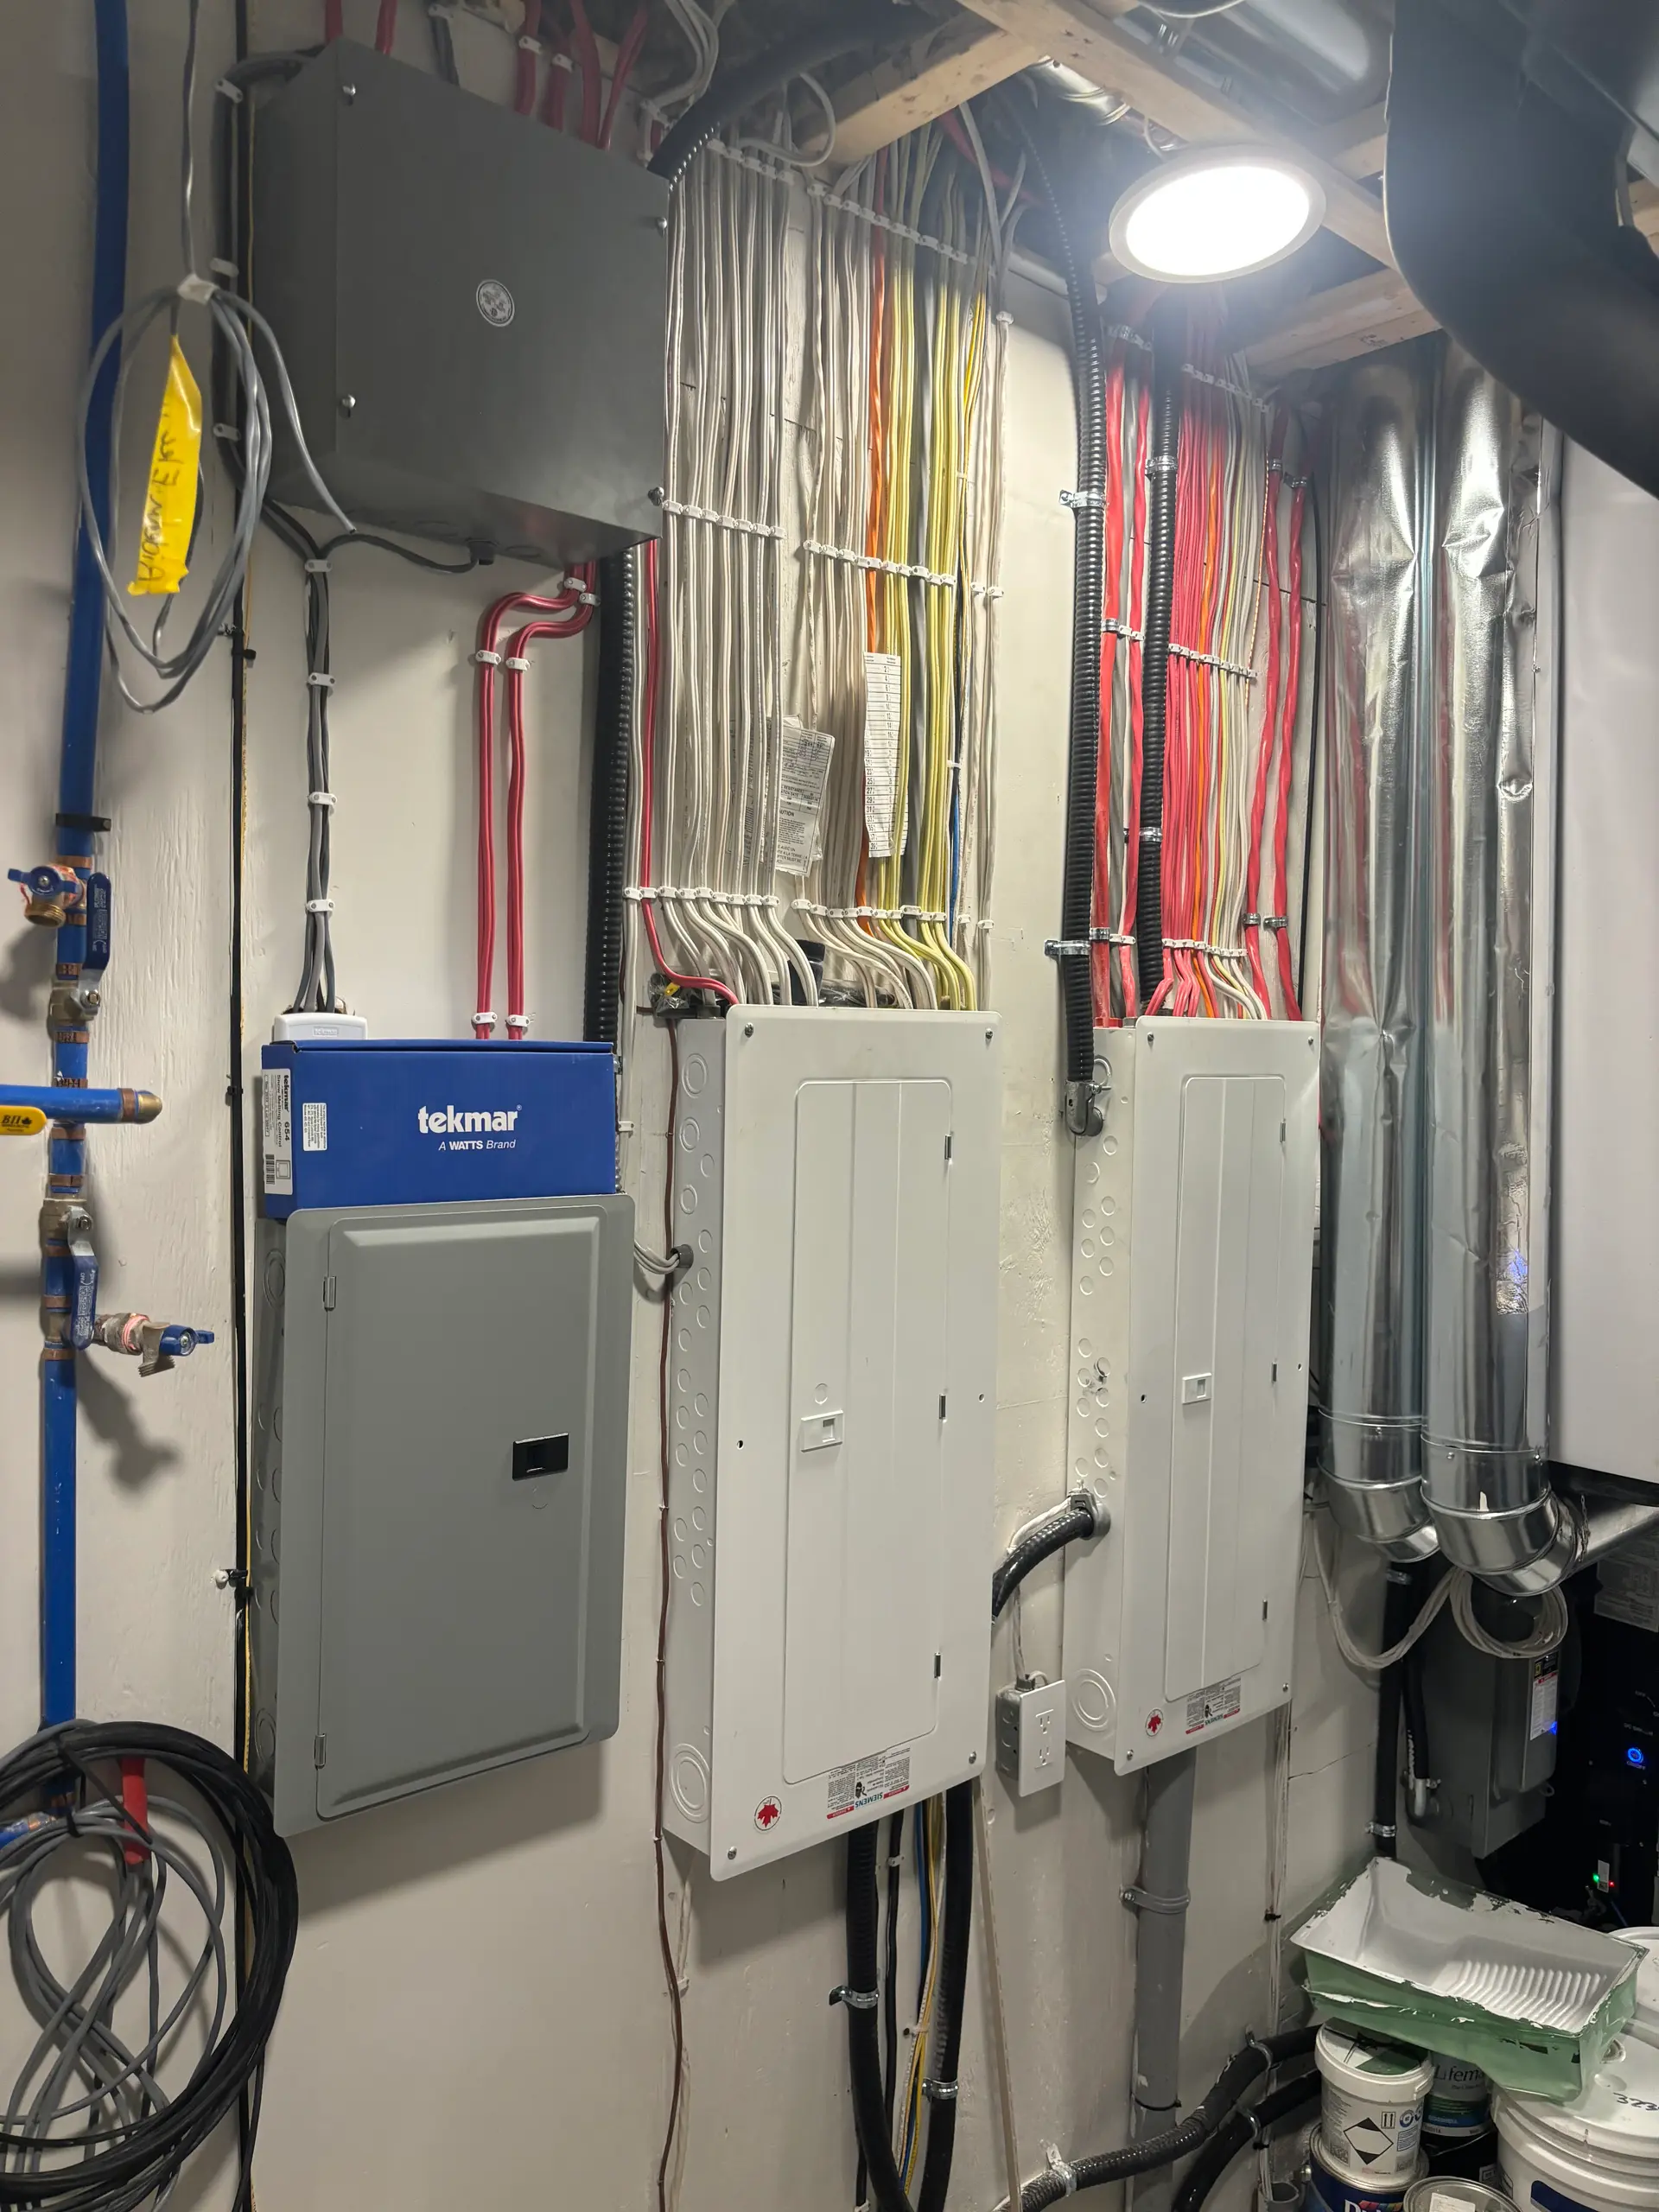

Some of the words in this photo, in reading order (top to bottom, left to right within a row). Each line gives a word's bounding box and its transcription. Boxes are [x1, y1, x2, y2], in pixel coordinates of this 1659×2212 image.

[418, 1105, 518, 1134] tekmar
[438, 1141, 446, 1150] A
[449, 1141, 483, 1150] WATTS
[486, 1140, 516, 1149] Brand
[855, 1792, 883, 1808] SIEMENS
